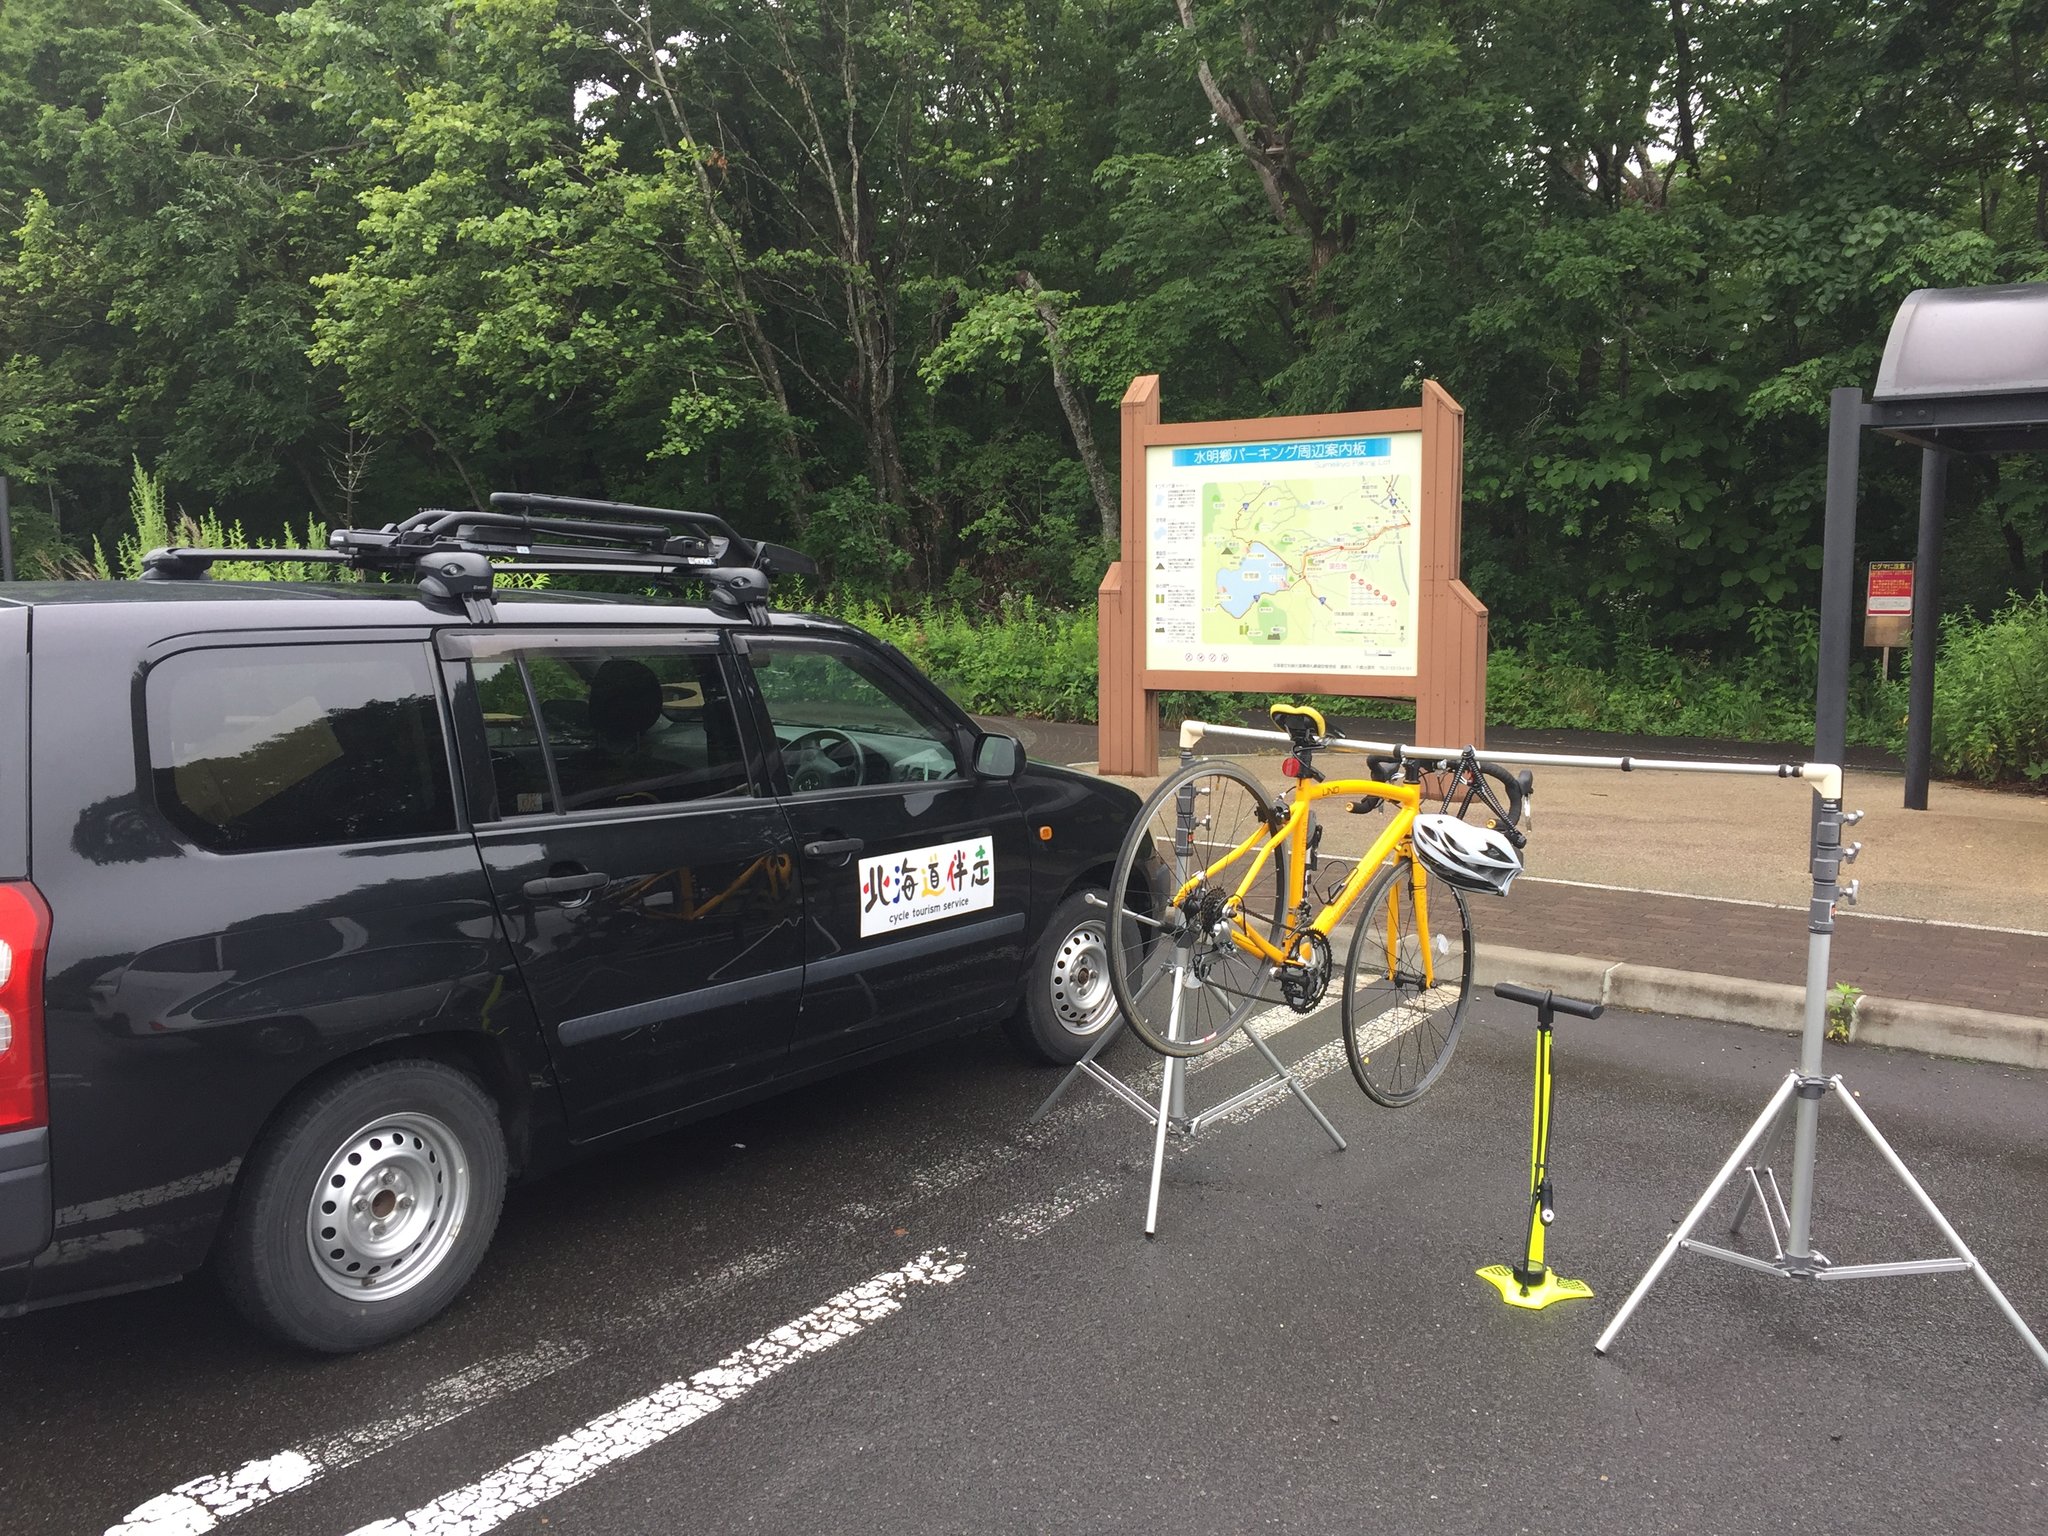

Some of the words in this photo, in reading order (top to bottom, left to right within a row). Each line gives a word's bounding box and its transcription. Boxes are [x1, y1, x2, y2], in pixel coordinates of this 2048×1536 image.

[1194, 441, 1367, 464] 水明郷パーキング周辺案内板
[888, 909, 910, 925] cycle
[912, 904, 941, 917] tourism
[943, 897, 969, 910] service
